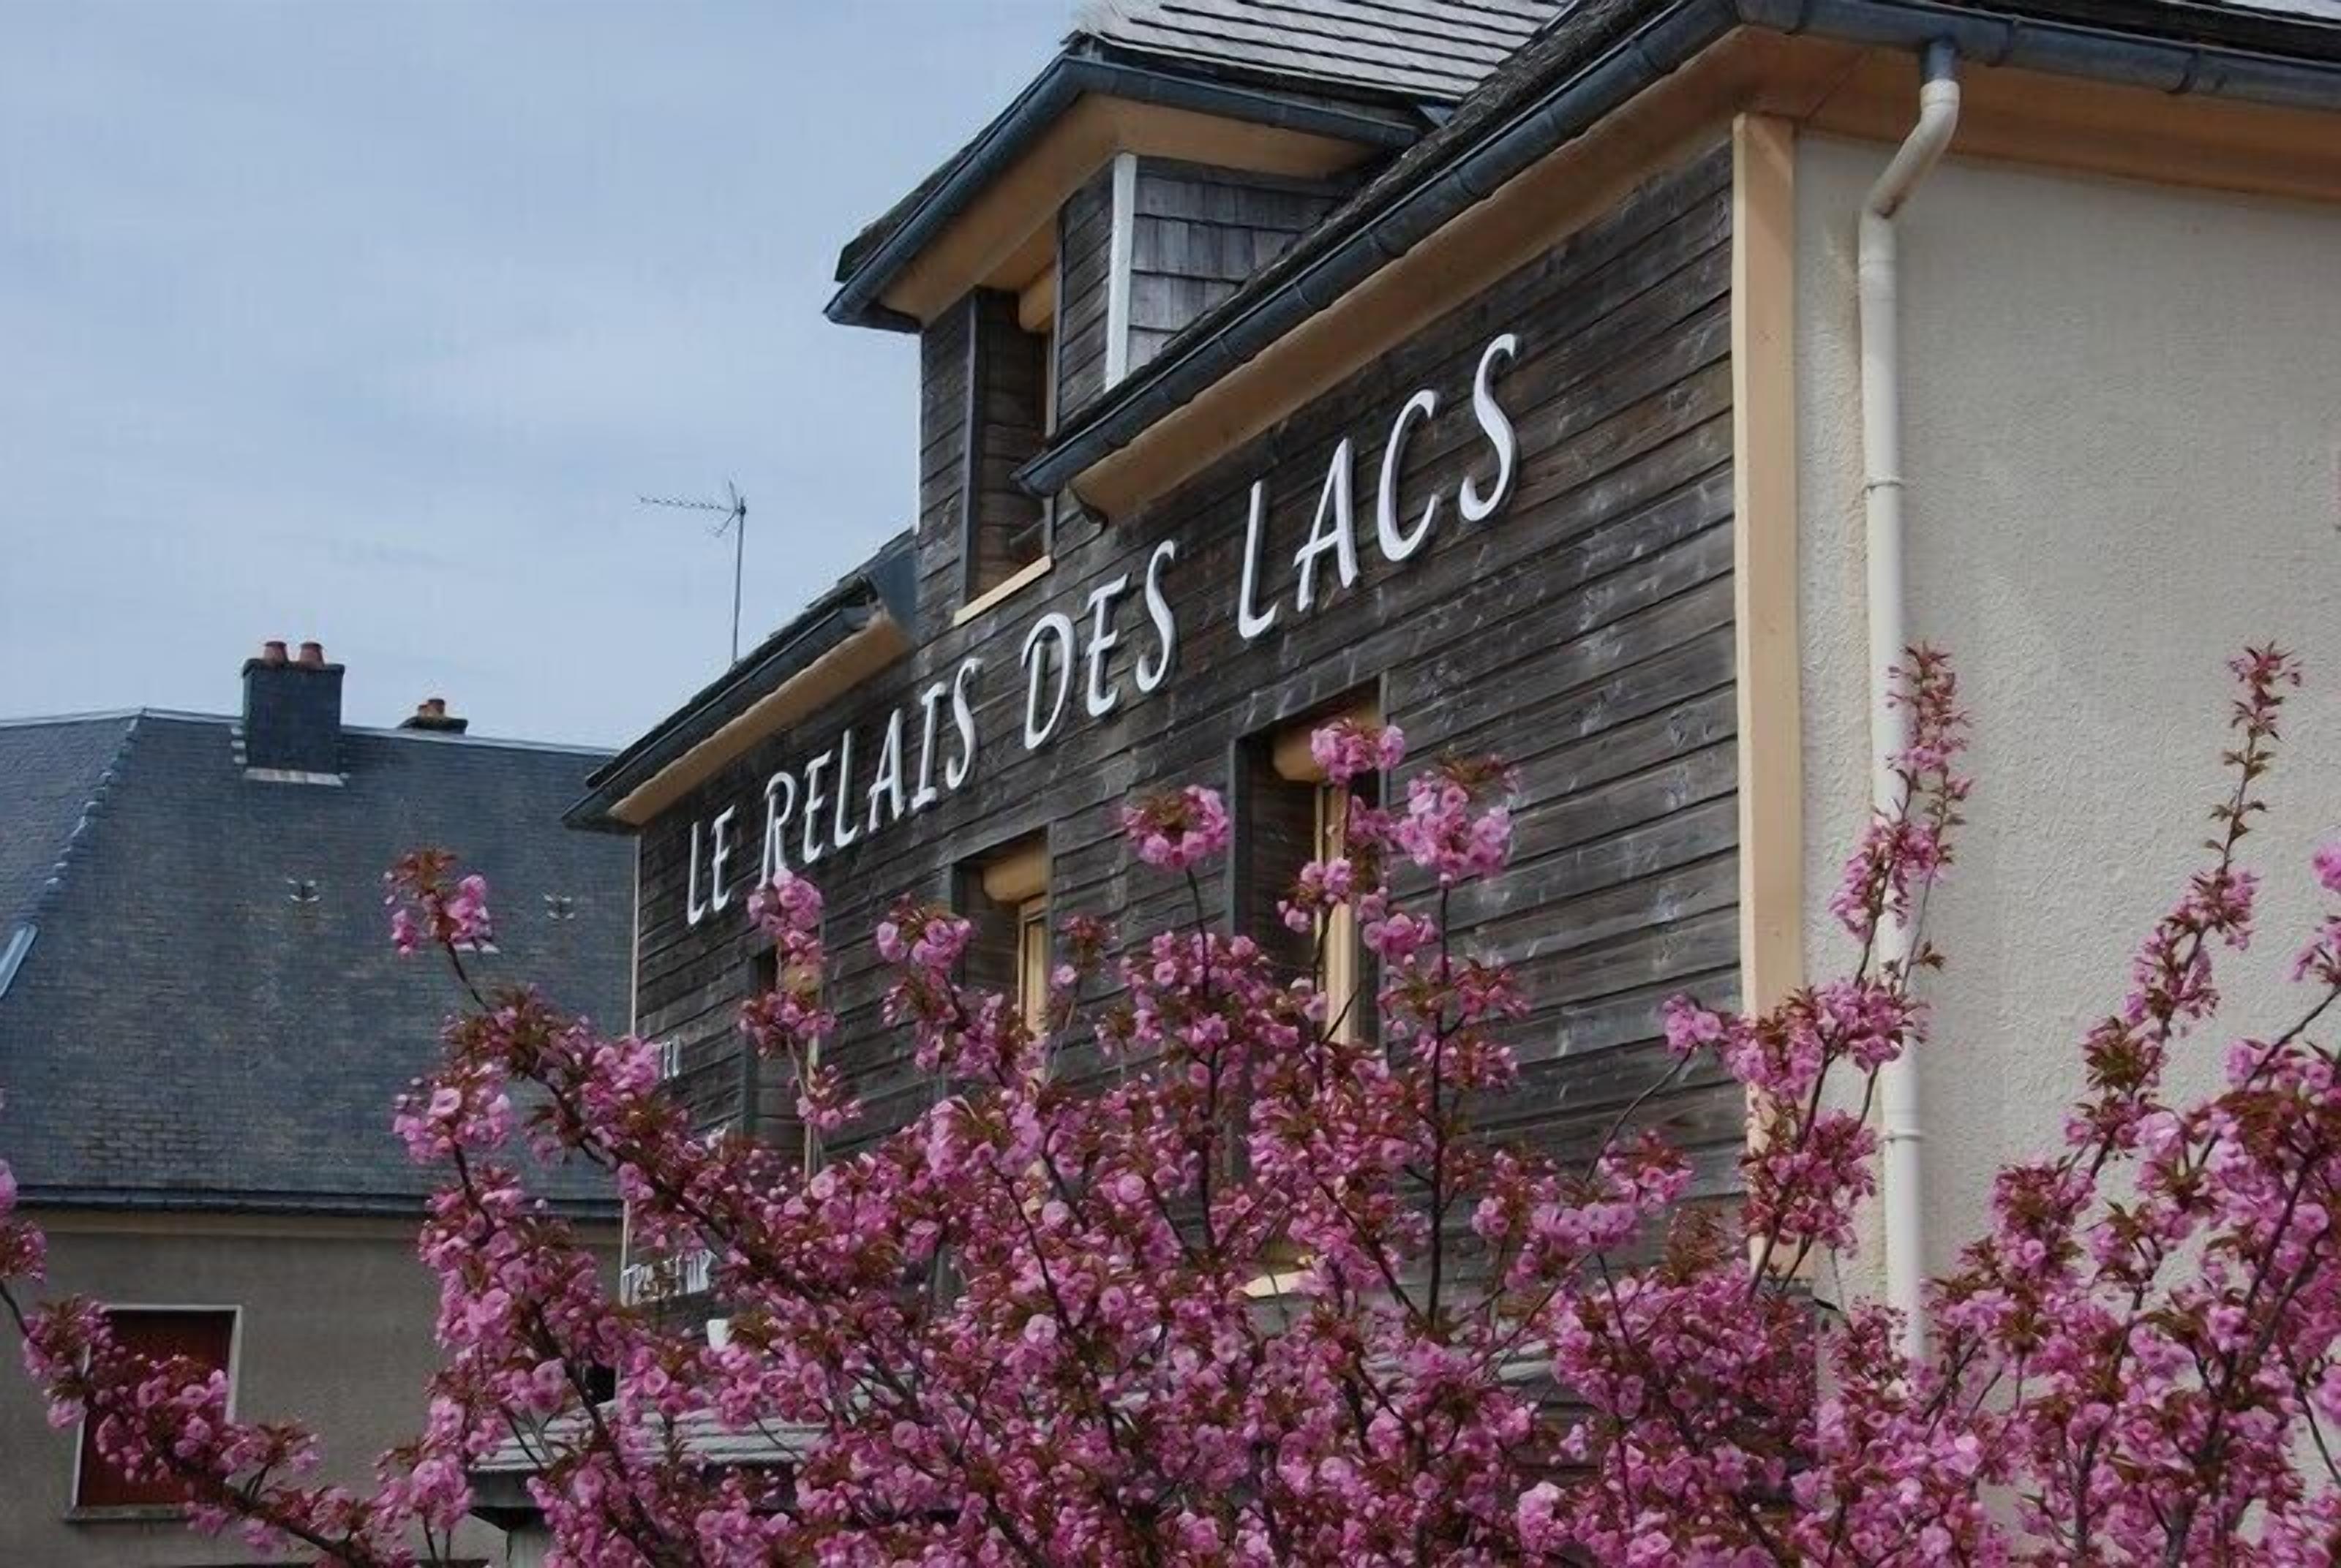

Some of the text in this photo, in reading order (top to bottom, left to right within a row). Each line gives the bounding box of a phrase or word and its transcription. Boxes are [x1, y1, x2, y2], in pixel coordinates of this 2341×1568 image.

[685, 332, 1519, 927] LE RELAIS DES LACS
